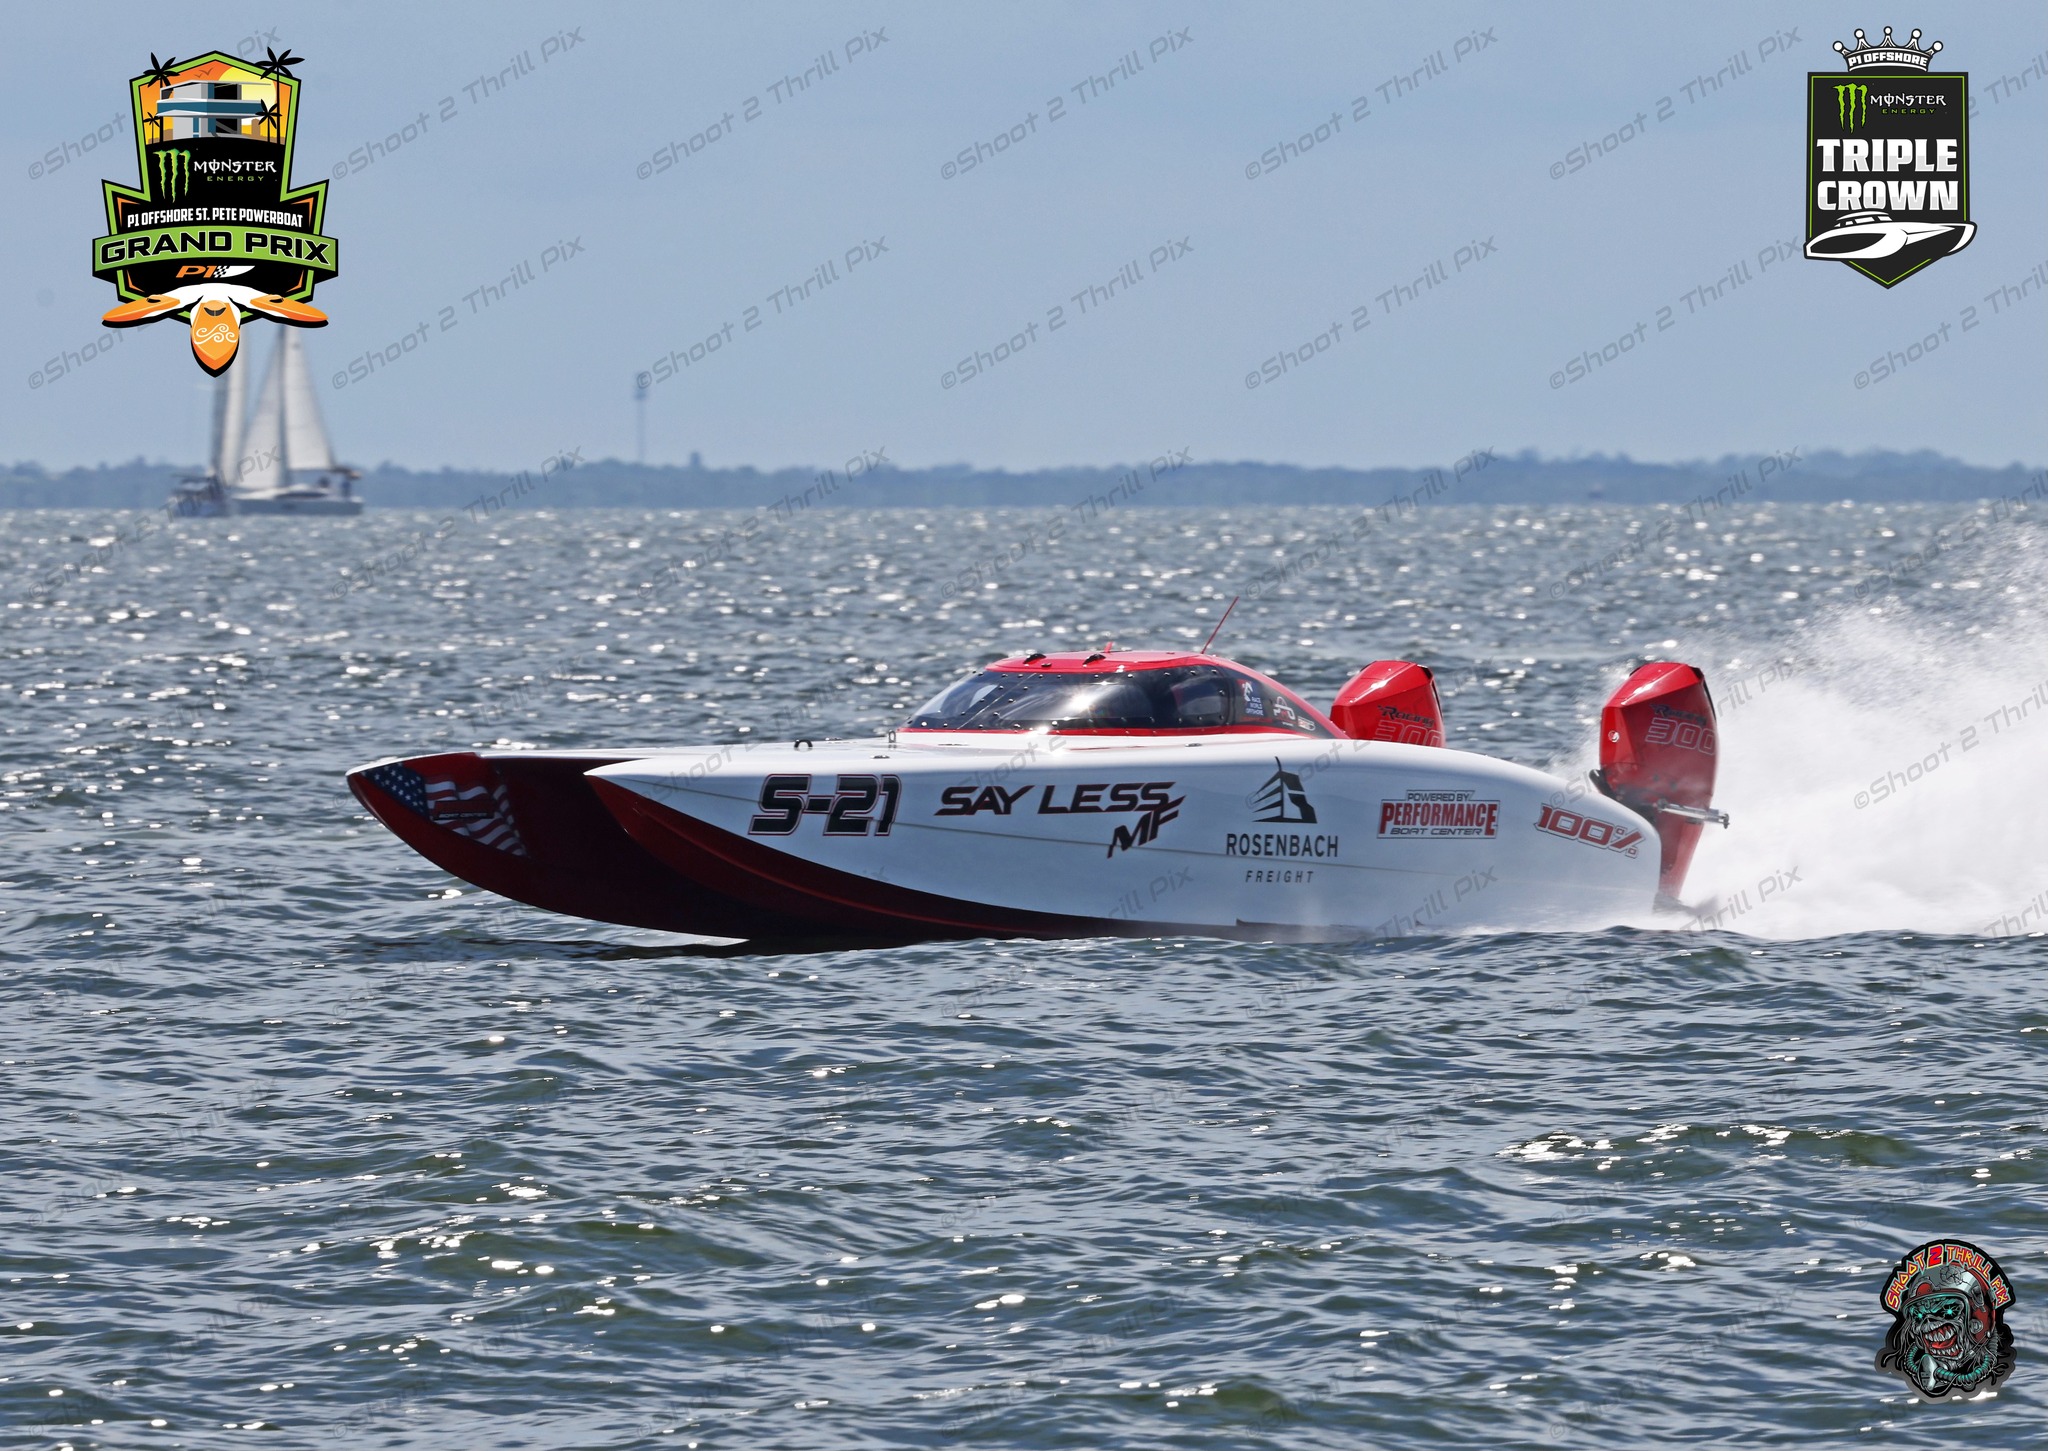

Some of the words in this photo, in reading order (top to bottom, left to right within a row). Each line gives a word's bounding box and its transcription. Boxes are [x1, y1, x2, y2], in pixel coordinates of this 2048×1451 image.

[747, 773, 902, 836] S-21
[934, 785, 1035, 816] SAY
[1037, 781, 1177, 815] LESS
[1407, 792, 1453, 802] POWERED
[1455, 792, 1470, 802] BY
[1107, 795, 1186, 859] MF
[1381, 802, 1498, 836] PERFORMANCE
[1390, 827, 1427, 836] BOAT
[1429, 827, 1483, 836] CENTER
[1534, 803, 1645, 859] 100%
[1226, 833, 1339, 858] ROSENBACH
[1245, 870, 1314, 884] FREIGHT
